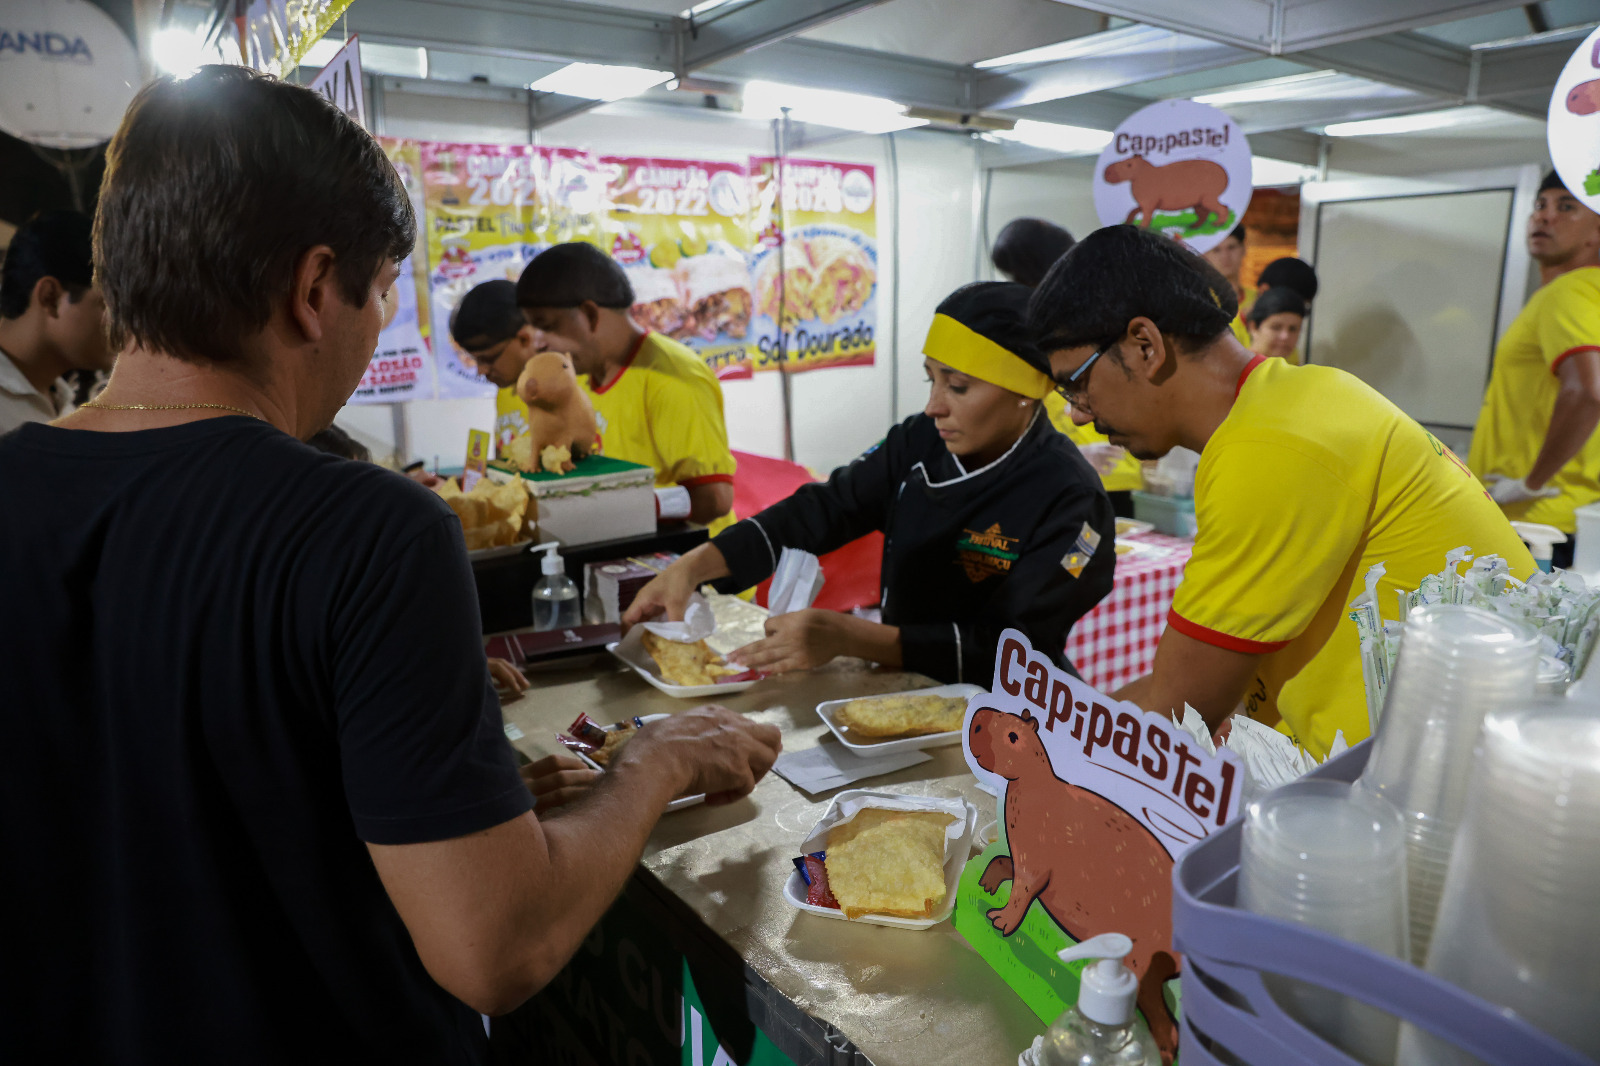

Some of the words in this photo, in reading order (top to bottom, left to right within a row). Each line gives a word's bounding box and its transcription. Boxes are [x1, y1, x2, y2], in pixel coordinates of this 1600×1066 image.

[1115, 124, 1230, 155] Capipastel
[638, 187, 709, 216] 2022
[797, 320, 874, 359] Dourado
[998, 638, 1236, 827] Capipastel
